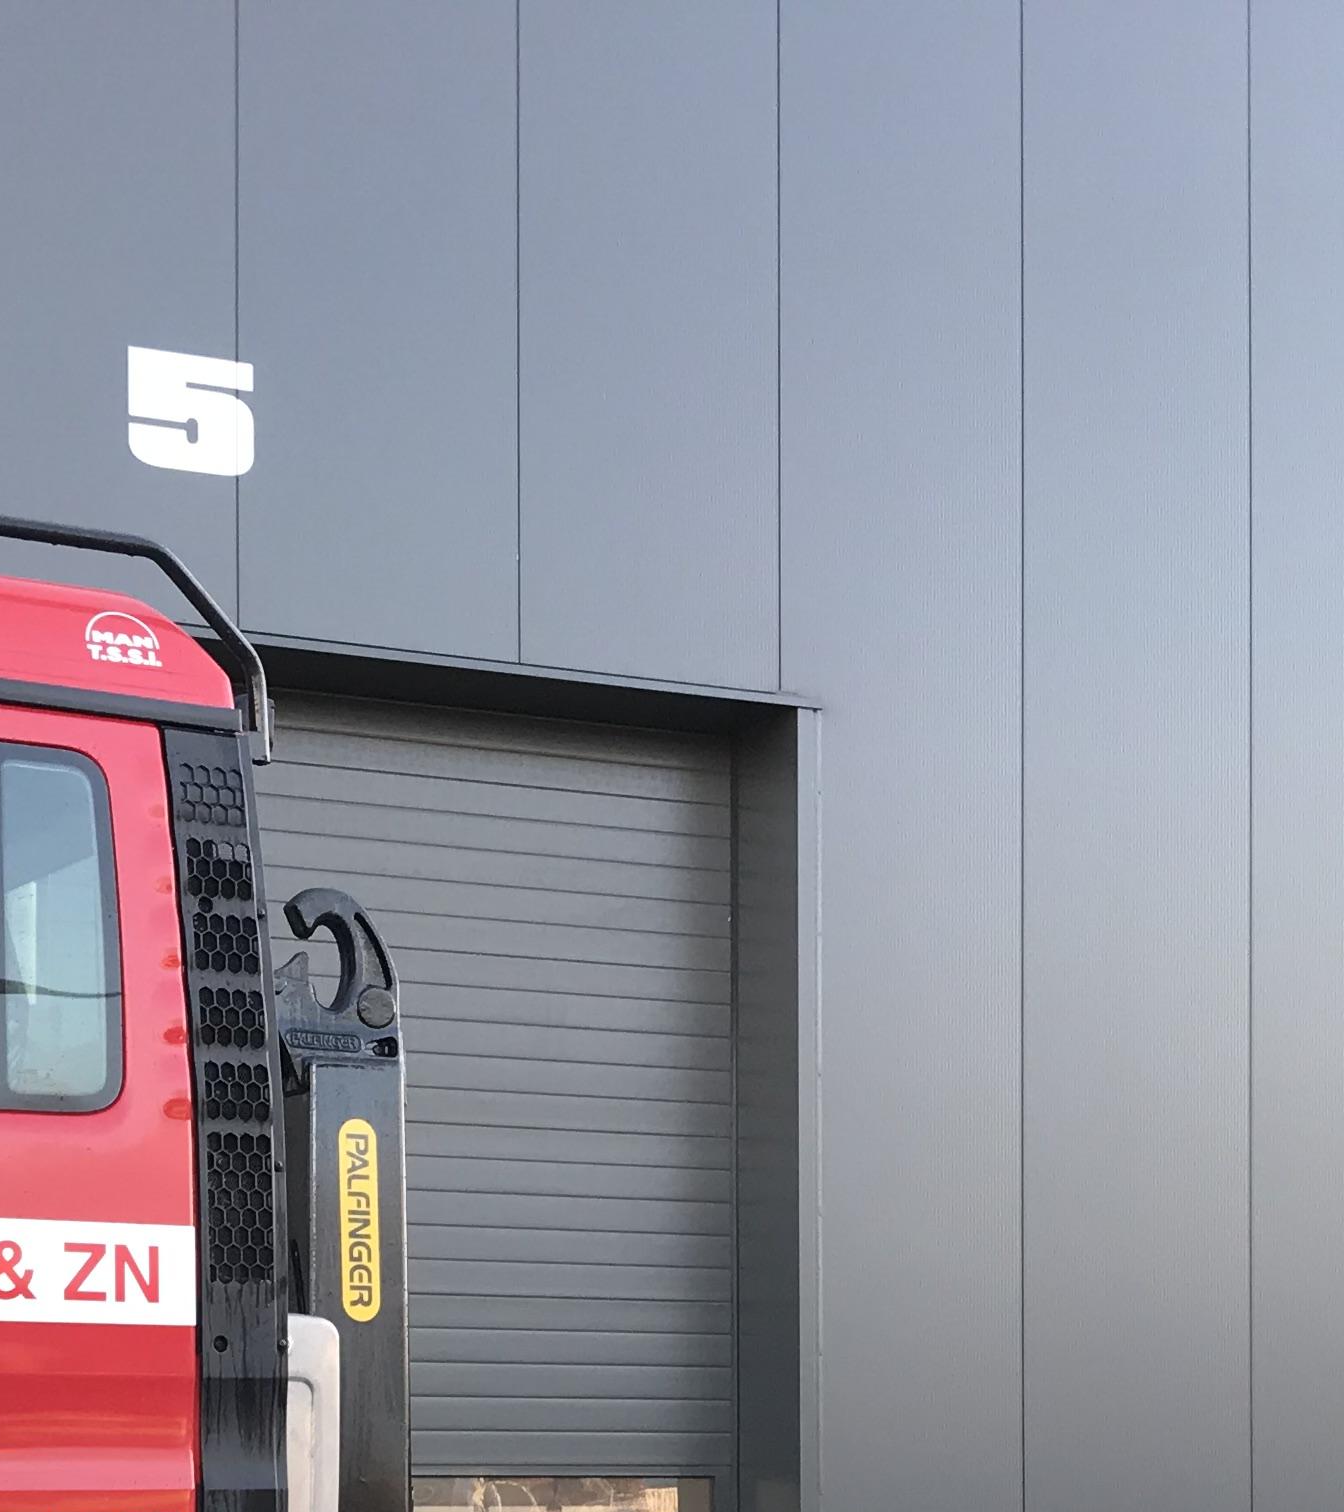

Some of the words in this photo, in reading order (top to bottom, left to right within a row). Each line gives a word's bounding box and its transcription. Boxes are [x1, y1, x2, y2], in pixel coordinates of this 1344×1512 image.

[128, 346, 254, 476] 5
[92, 630, 154, 649] MAN
[345, 1132, 373, 1309] PALFINGER
[65, 1243, 159, 1303] ZN
